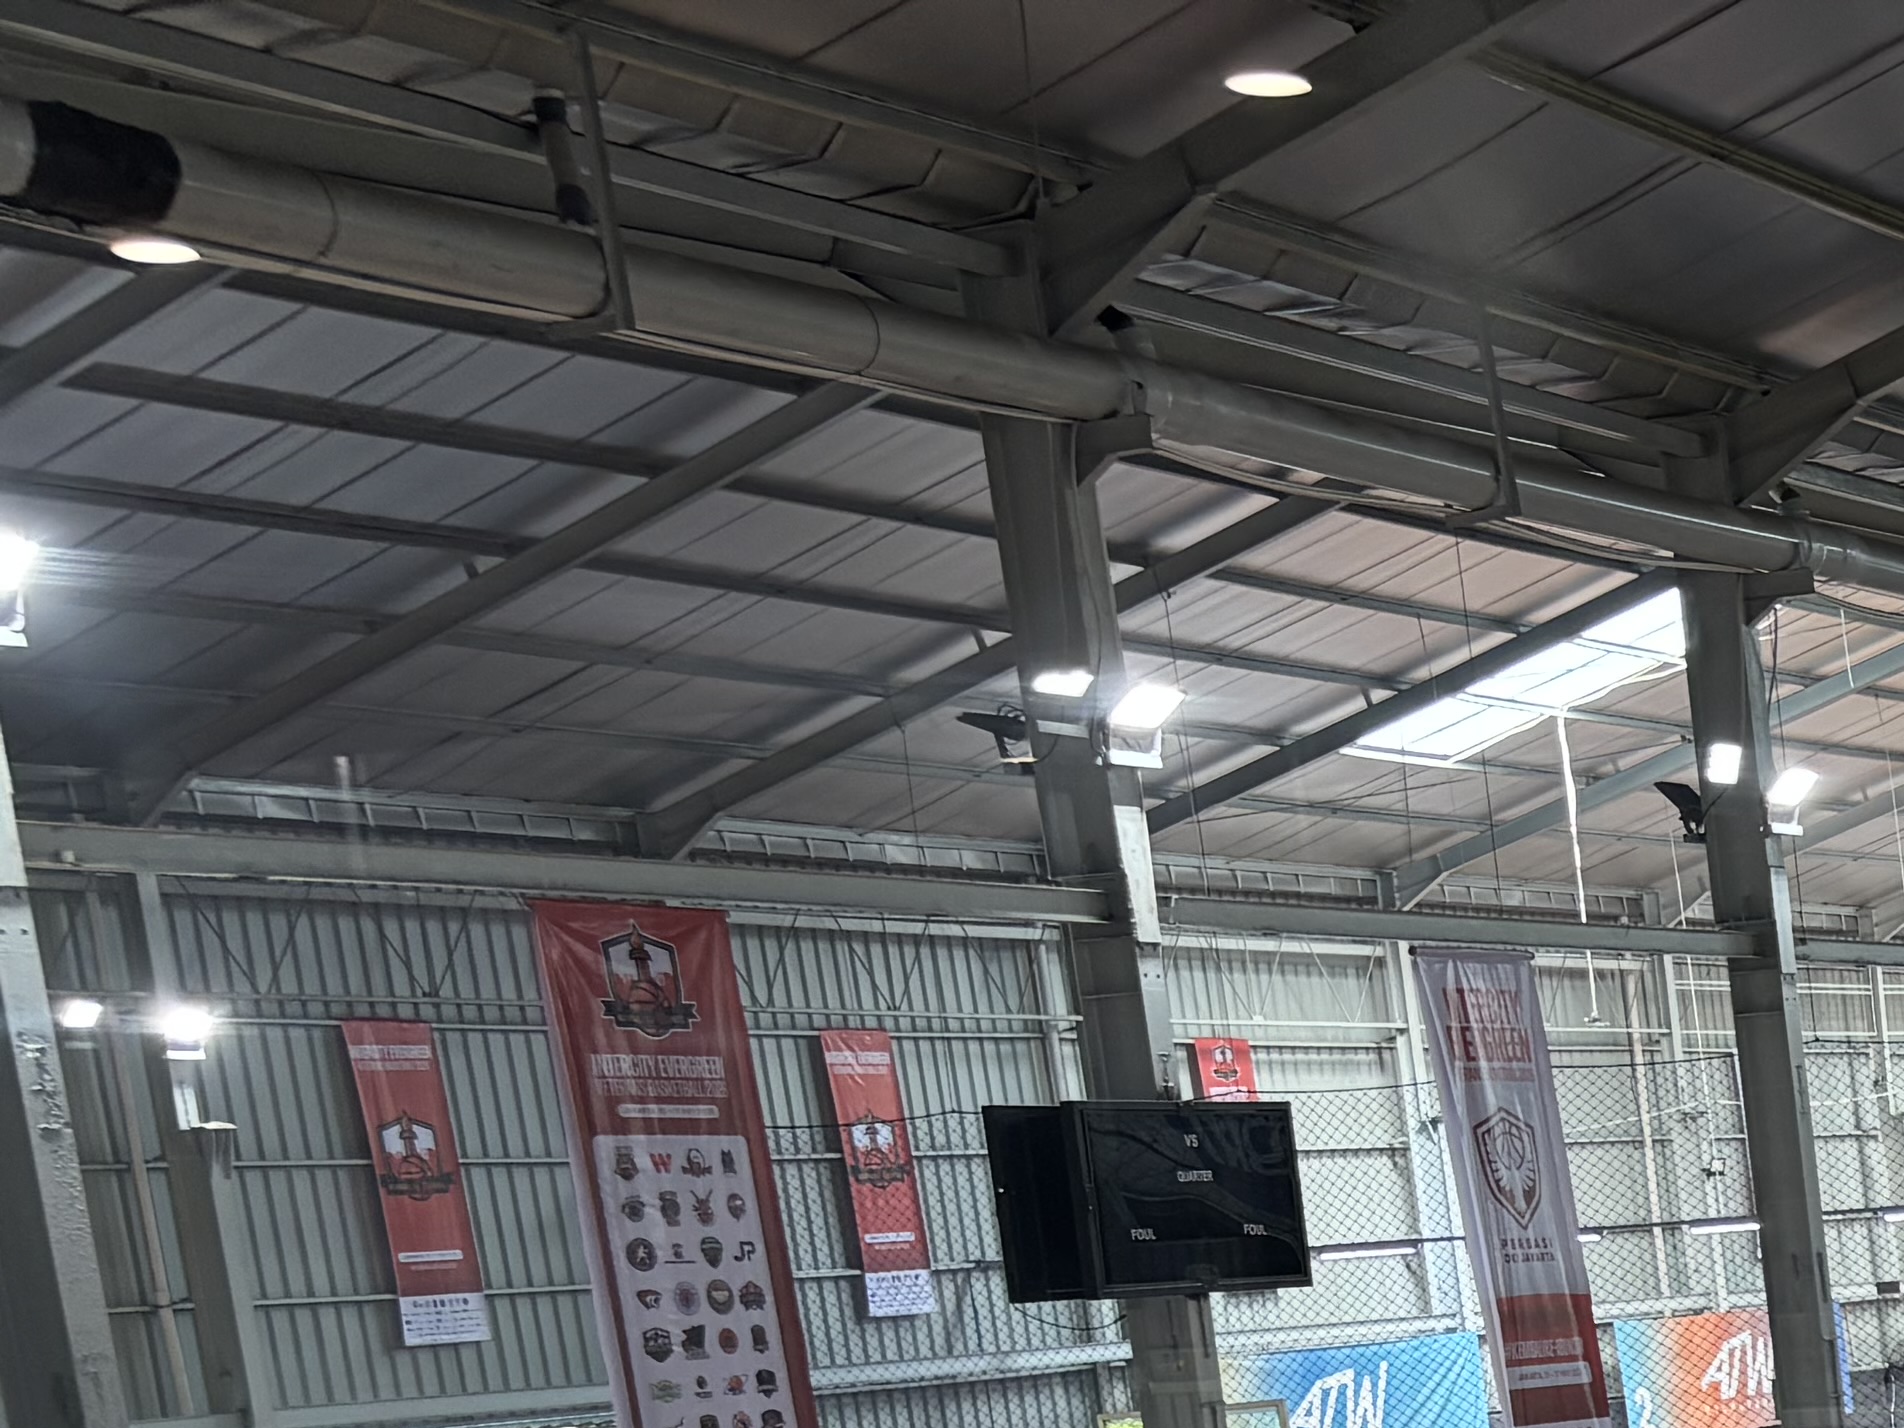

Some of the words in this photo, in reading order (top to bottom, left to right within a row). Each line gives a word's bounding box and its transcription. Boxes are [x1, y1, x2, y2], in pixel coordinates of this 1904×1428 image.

[1183, 1134, 1199, 1148] VS
[1131, 1228, 1157, 1240] FOUL
[1243, 1223, 1268, 1236] FOUL
